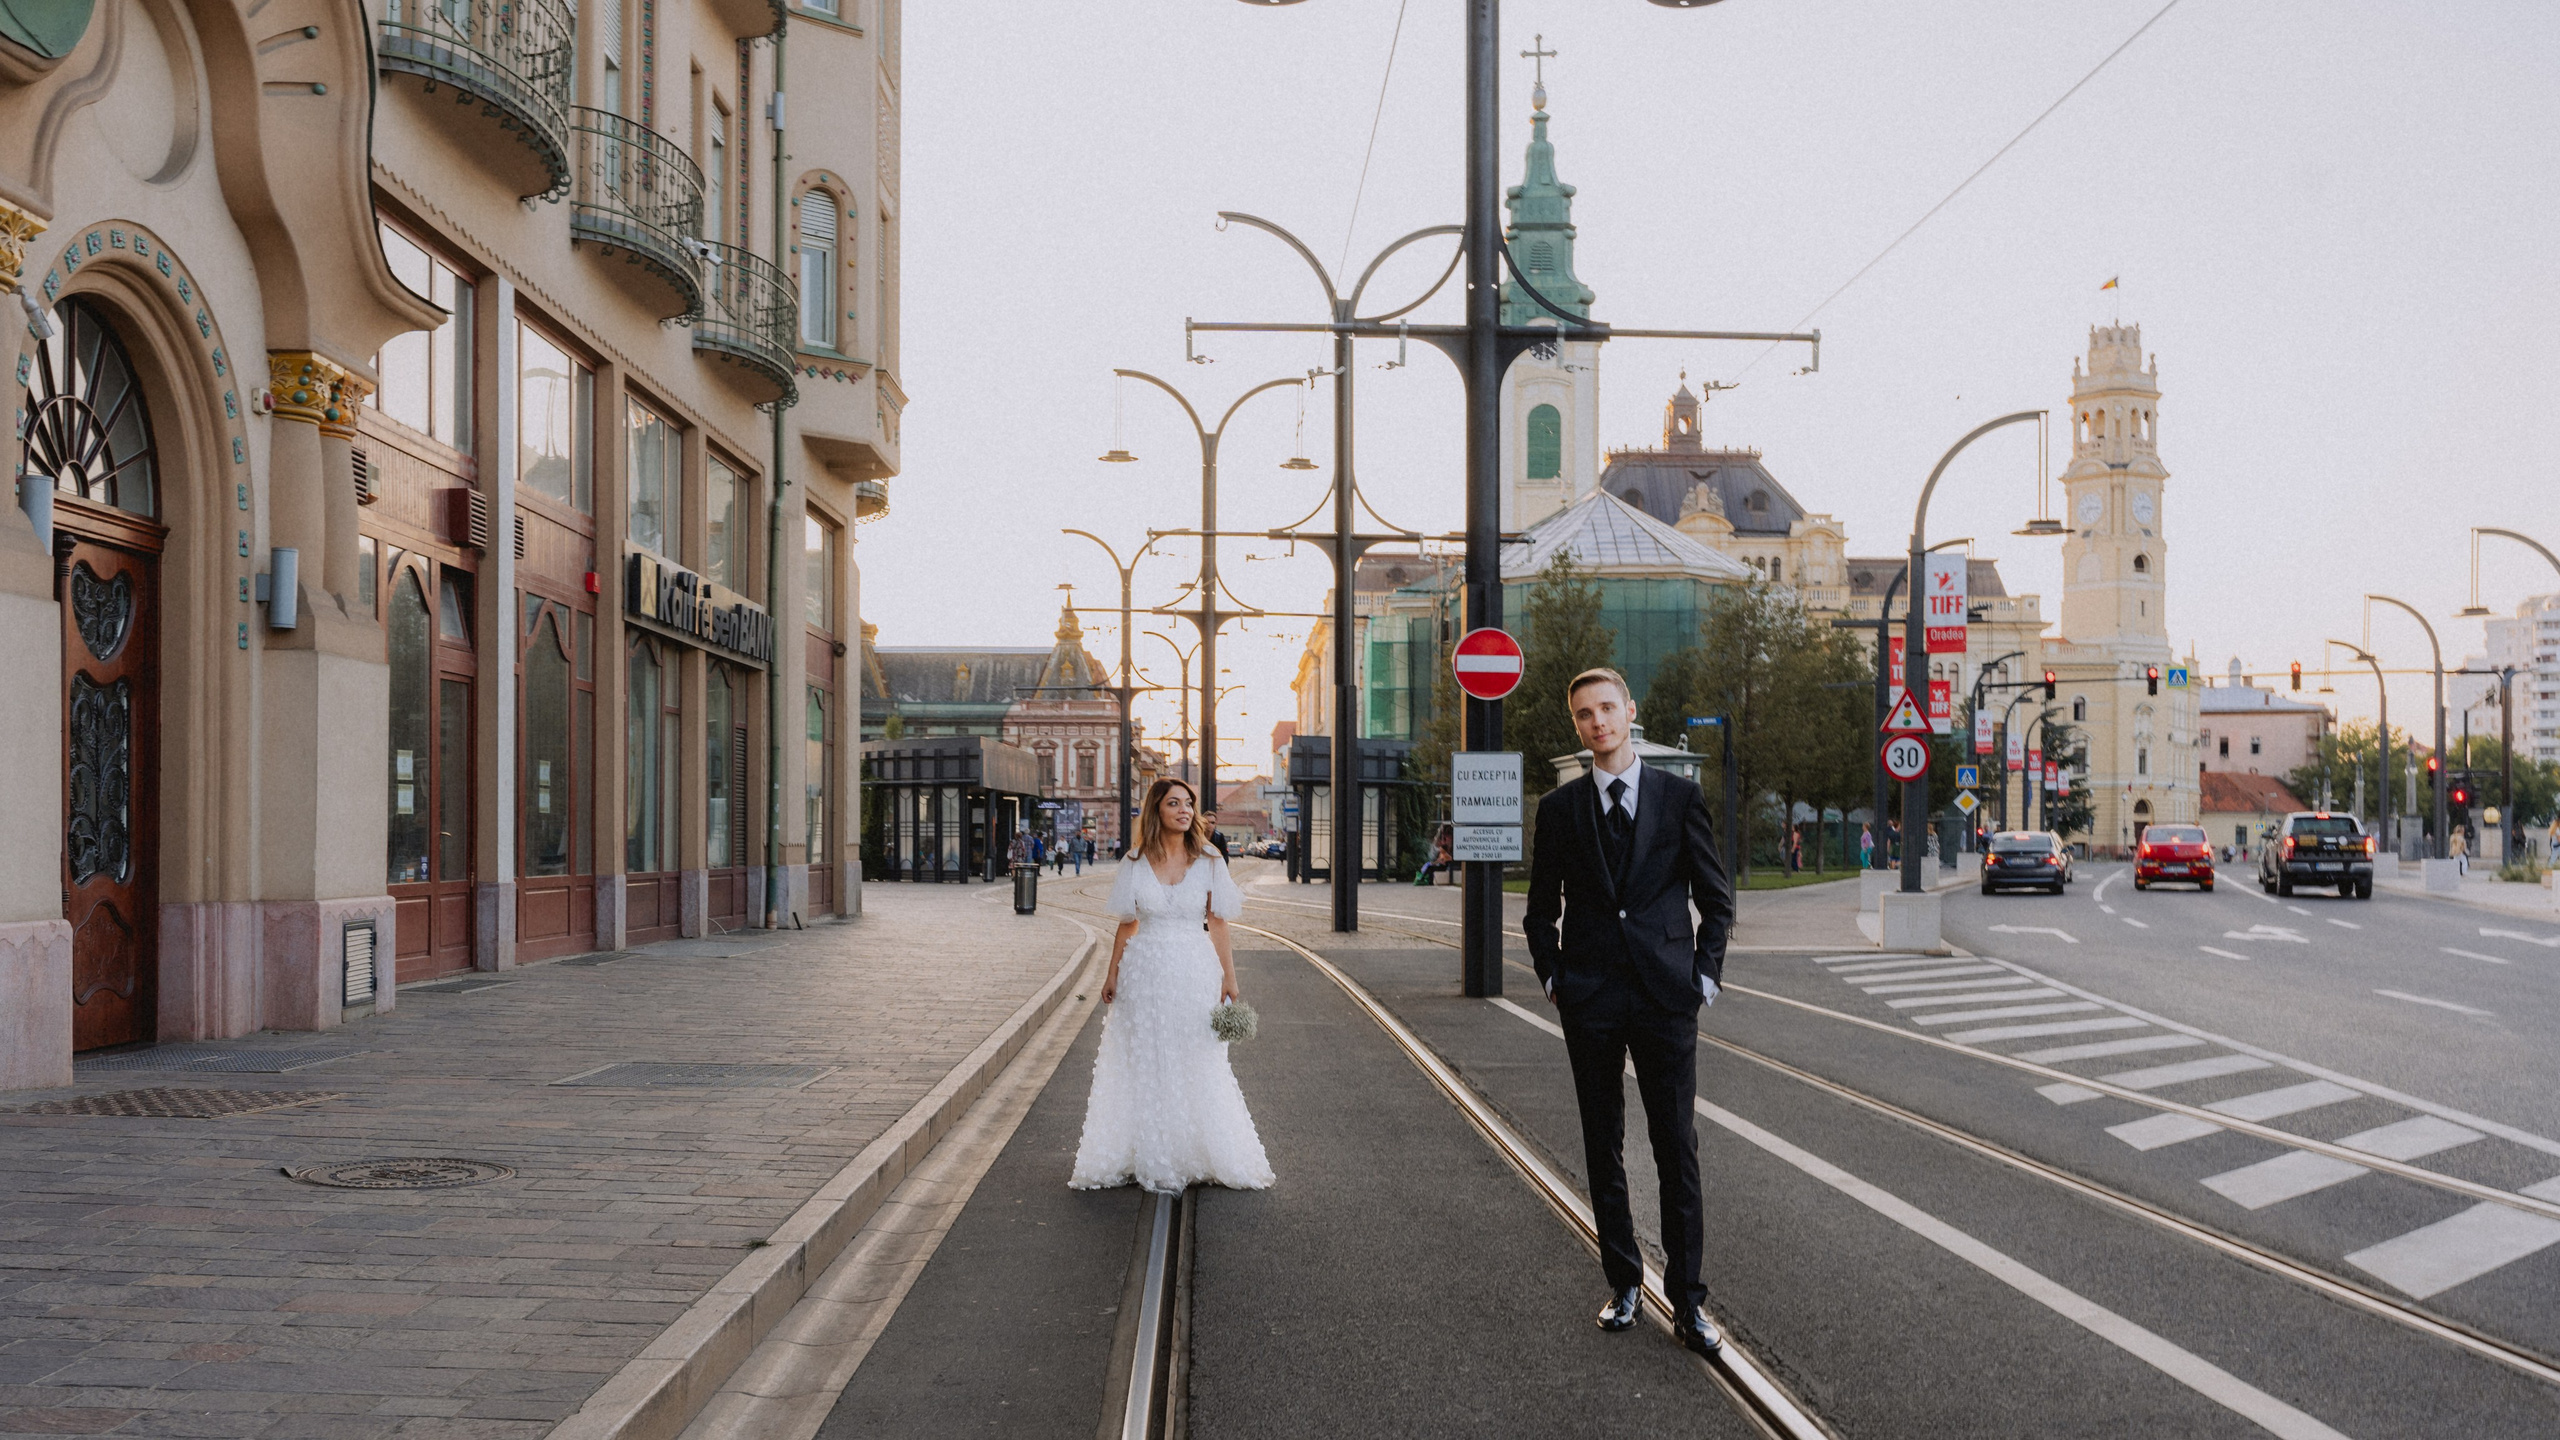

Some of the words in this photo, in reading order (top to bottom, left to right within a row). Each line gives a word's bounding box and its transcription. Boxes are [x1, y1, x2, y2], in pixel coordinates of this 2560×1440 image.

[1929, 595, 1964, 615] TIFF
[1930, 628, 1964, 641] Oradea
[1930, 702, 1949, 714] TIFF
[1893, 747, 1919, 768] 30
[1457, 770, 1470, 781] CU
[1455, 796, 1519, 807] TRAMVAIELOR
